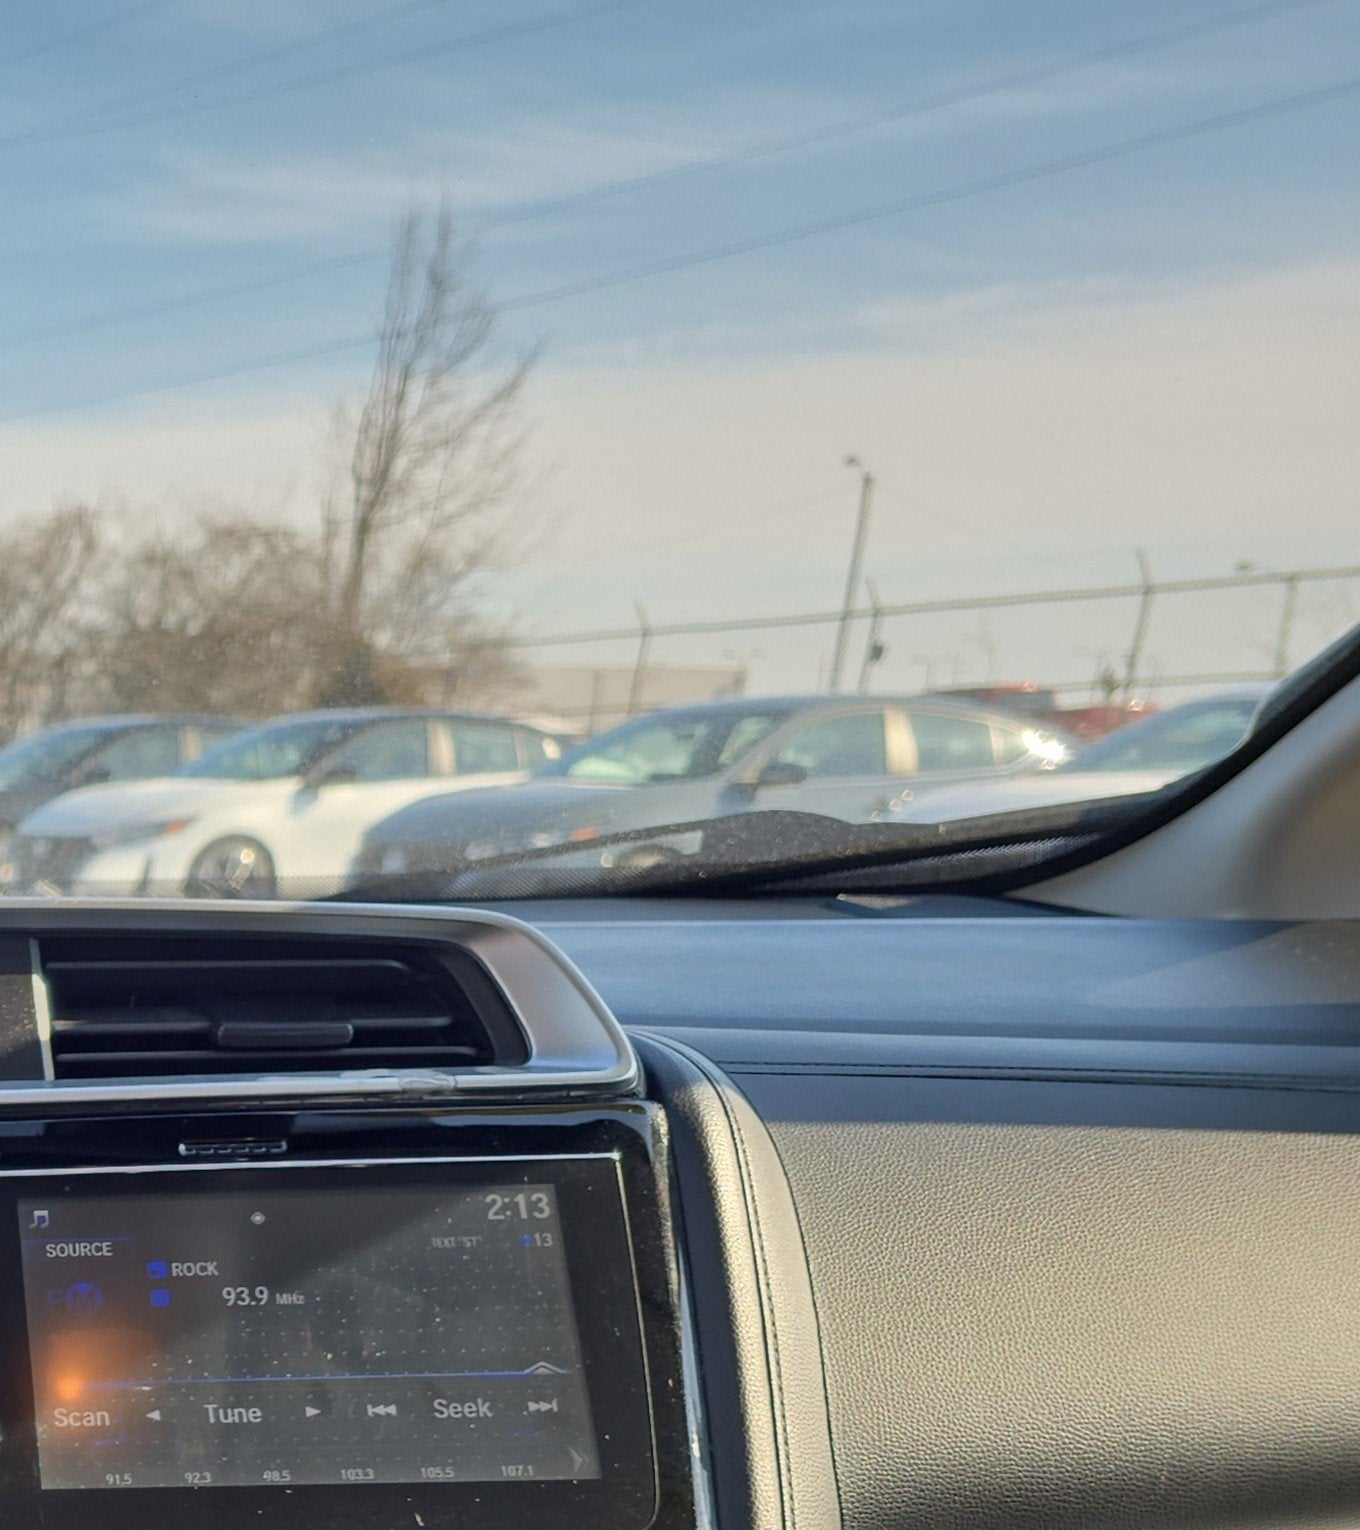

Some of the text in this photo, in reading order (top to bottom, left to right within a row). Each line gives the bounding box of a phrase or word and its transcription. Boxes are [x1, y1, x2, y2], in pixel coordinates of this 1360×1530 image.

[485, 1192, 551, 1220] 2:13
[534, 1232, 553, 1247] 13
[46, 1242, 113, 1259] SOURCE
[171, 1261, 219, 1278] ROCK
[222, 1285, 306, 1306] 93.9 MHz
[54, 1408, 110, 1428] Scan
[204, 1404, 262, 1425] Tune
[434, 1398, 493, 1420] Seek
